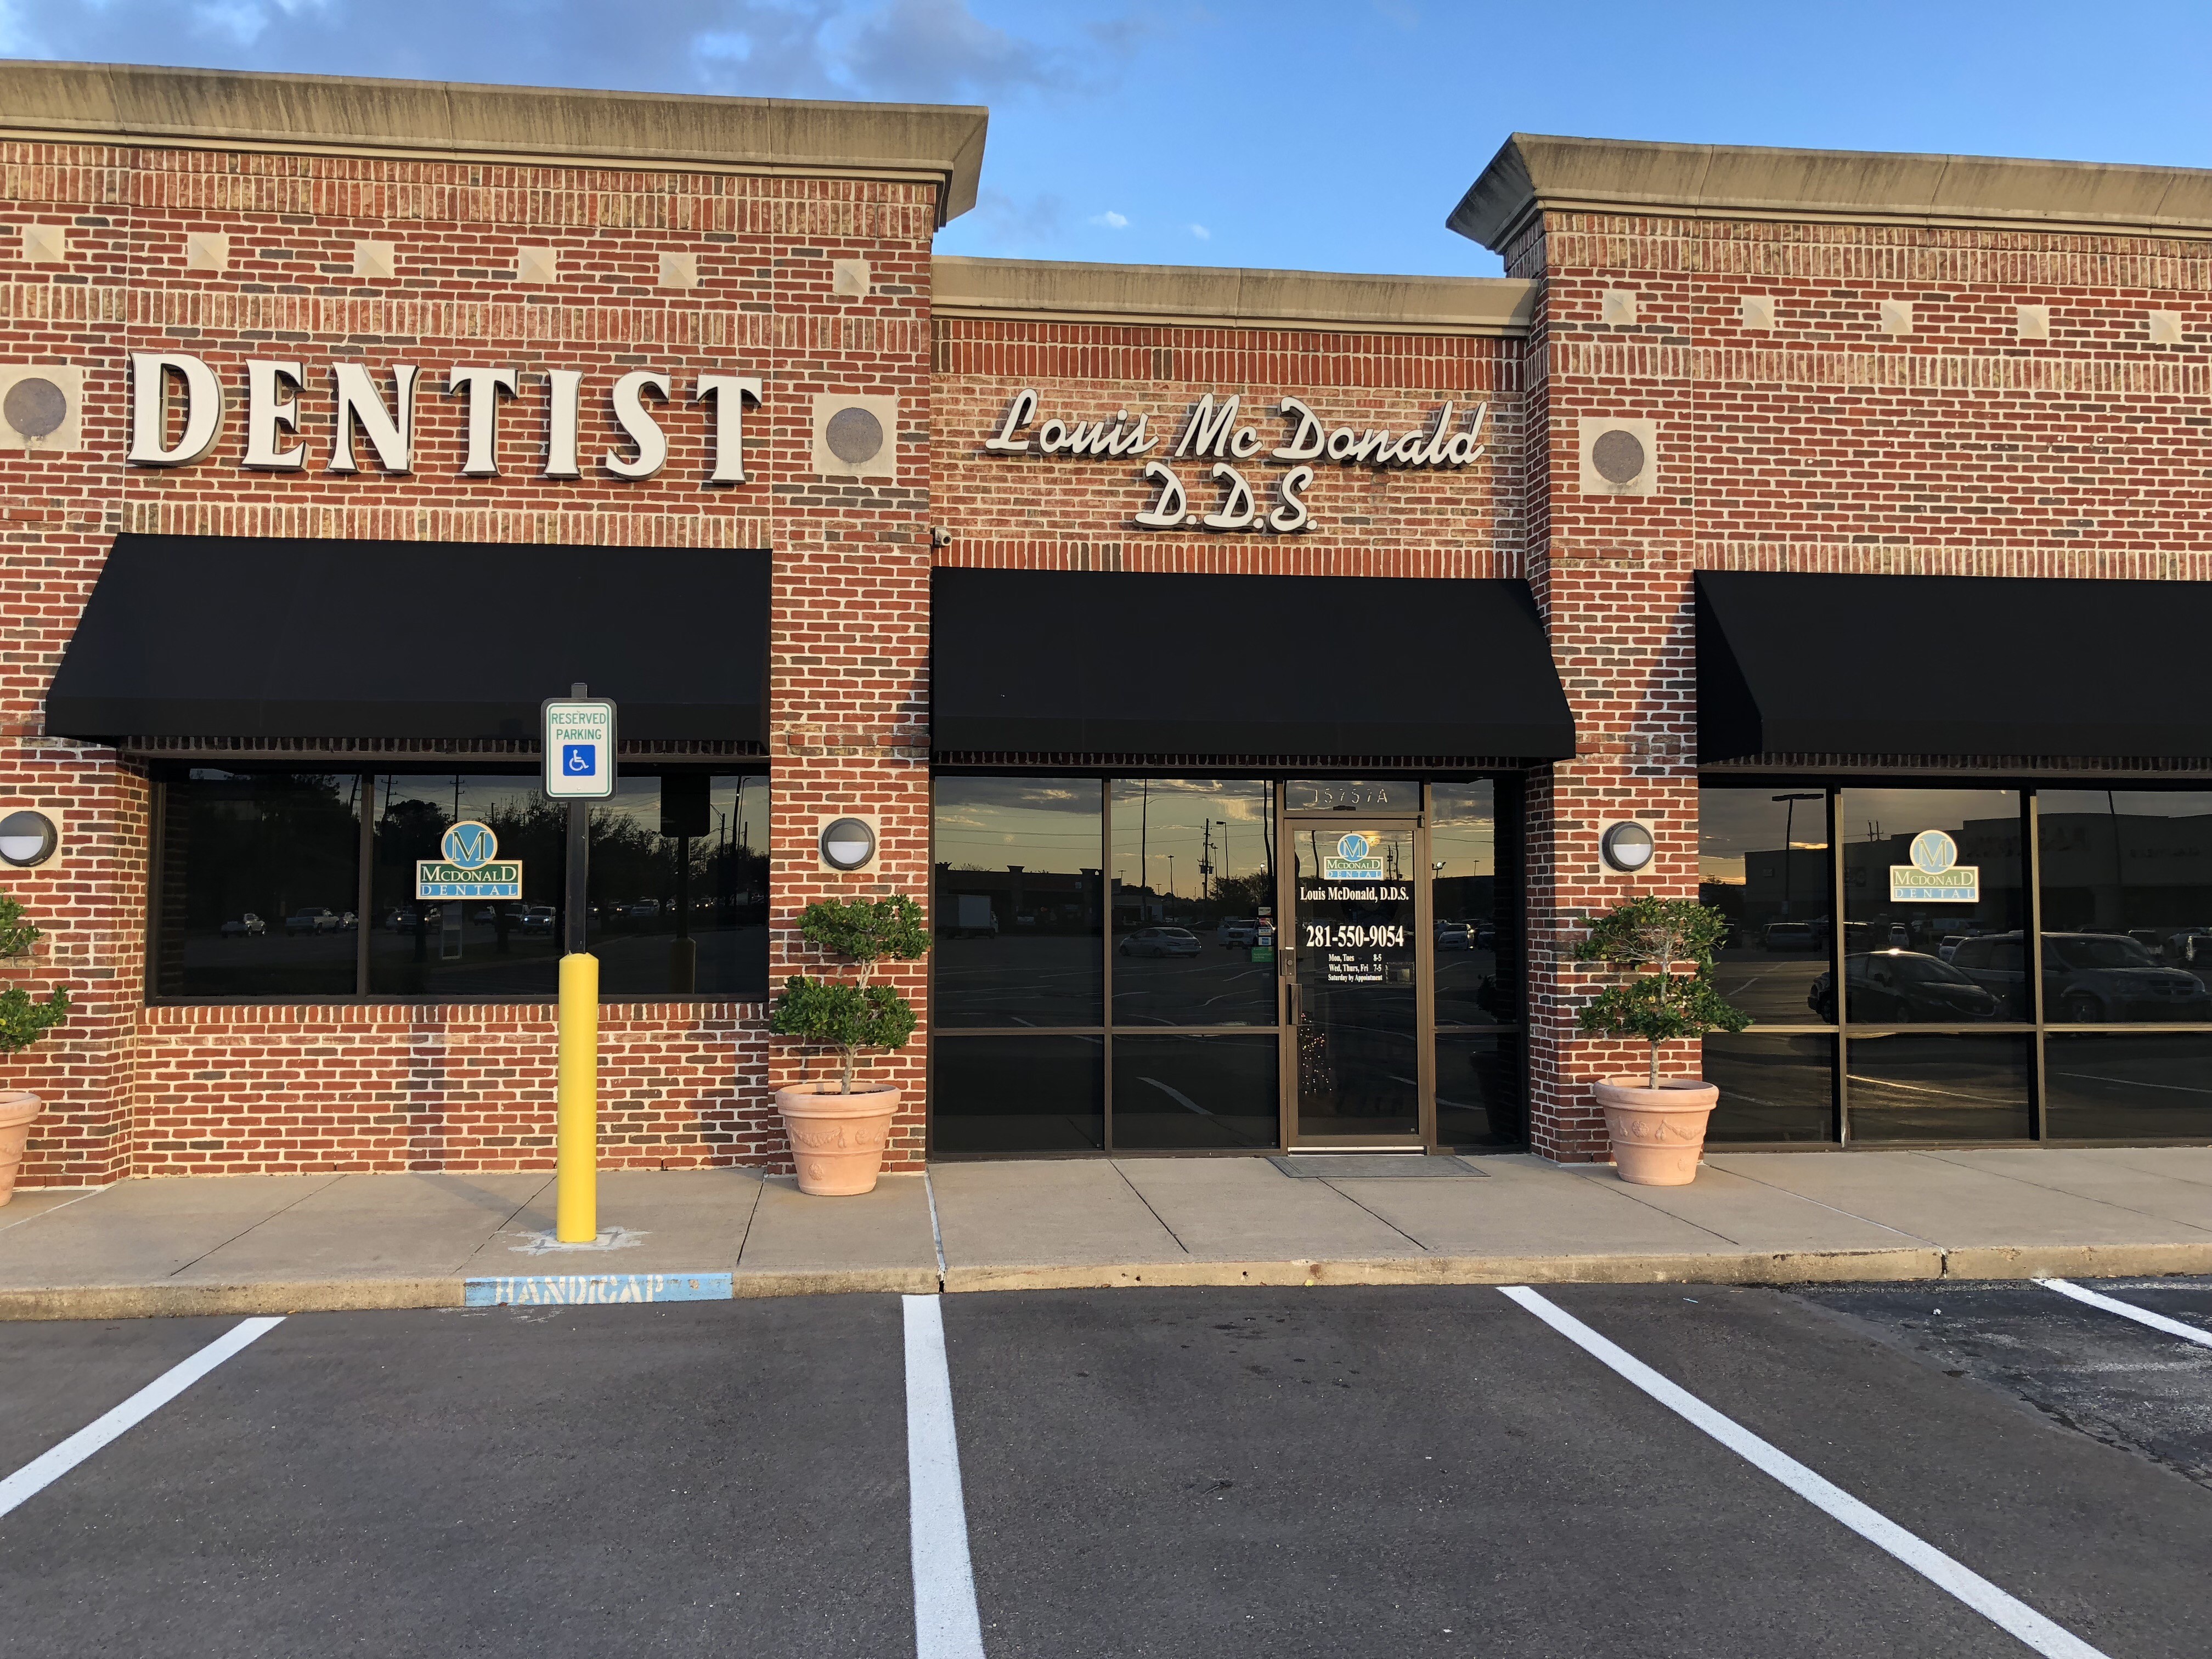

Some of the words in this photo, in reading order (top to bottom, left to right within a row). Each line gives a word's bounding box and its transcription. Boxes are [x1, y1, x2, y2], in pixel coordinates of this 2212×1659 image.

[127, 352, 764, 484] DENTIST
[986, 388, 1159, 458] Louis
[1133, 461, 1318, 533] D.D.S.
[551, 713, 606, 724] RESERVED
[556, 729, 602, 740] PARKING
[449, 830, 490, 861] M
[1342, 838, 1365, 858] M
[1917, 838, 1951, 867] M
[421, 885, 517, 895] DENTAL
[1300, 887, 1325, 900] Louis
[1328, 887, 1378, 903] McDonald,
[1380, 887, 1409, 900] D.D.S.
[1894, 889, 1974, 898] DENTAL
[1306, 925, 1404, 947] 281-550-9054
[1328, 953, 1342, 963] Mon,
[1342, 953, 1355, 962] Tues
[1373, 953, 1382, 962] 8-5
[1328, 964, 1342, 973] Wed,
[1342, 964, 1359, 973] Thurs,
[1360, 964, 1369, 972] Fri
[1373, 964, 1382, 972] 7-5
[1328, 974, 1348, 982] Saturday
[1348, 974, 1355, 982] by
[1355, 974, 1383, 983] Appointment
[495, 1274, 664, 1305] HANDICAP
